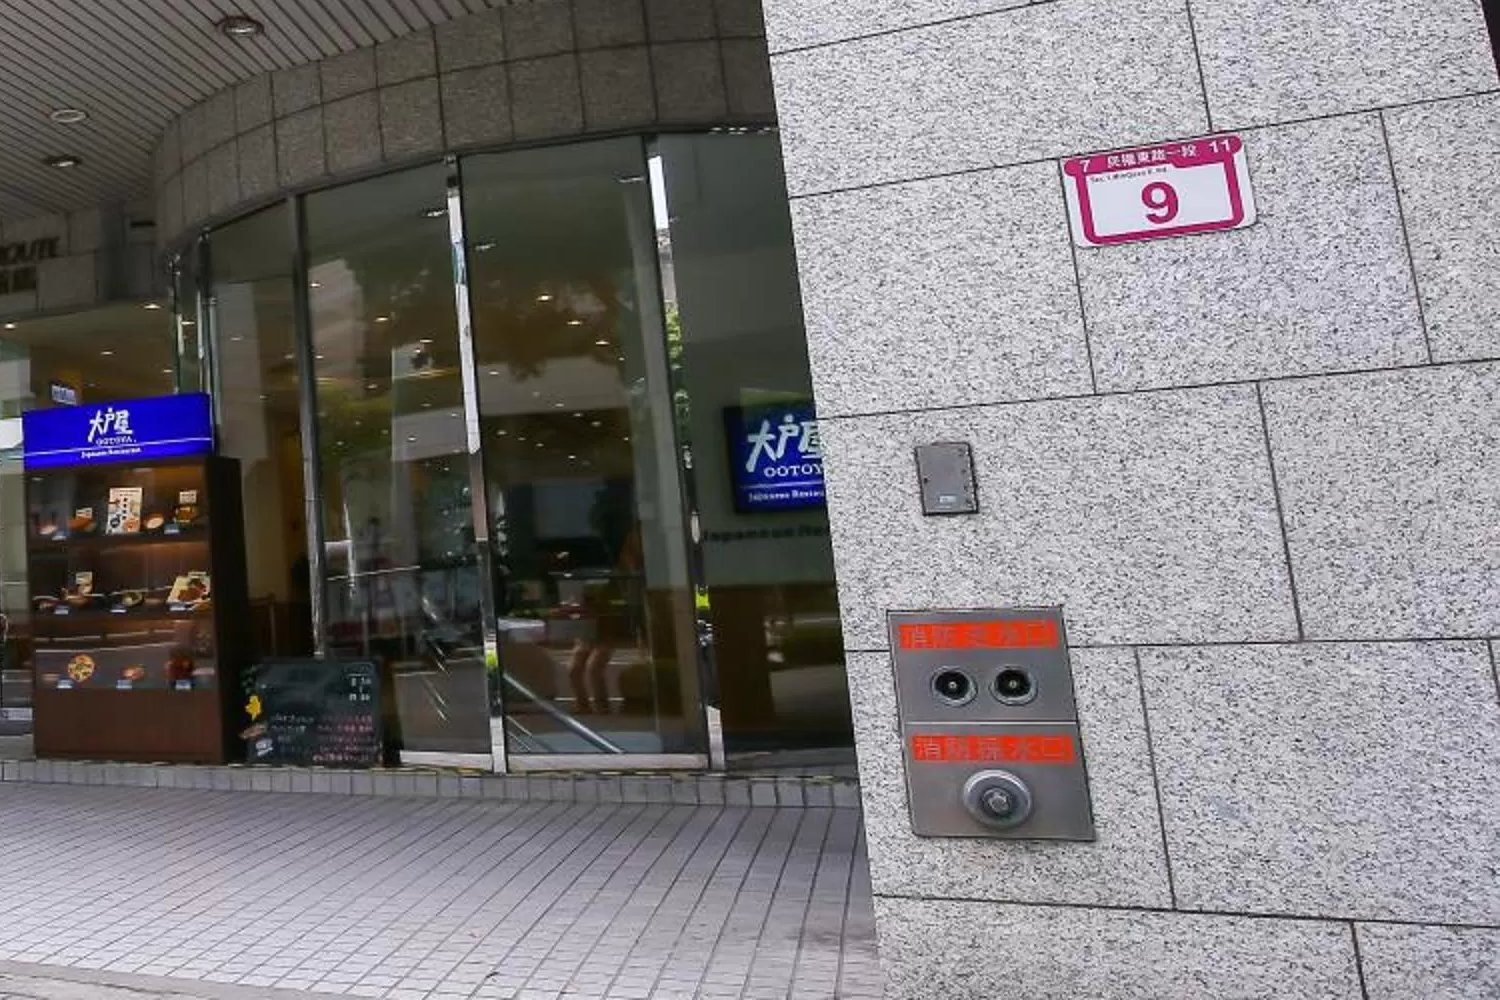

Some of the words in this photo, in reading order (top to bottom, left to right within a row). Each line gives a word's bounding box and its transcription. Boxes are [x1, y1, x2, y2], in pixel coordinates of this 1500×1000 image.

[1209, 139, 1231, 153] 11
[1079, 160, 1092, 173] 7
[1141, 181, 1179, 224] 9
